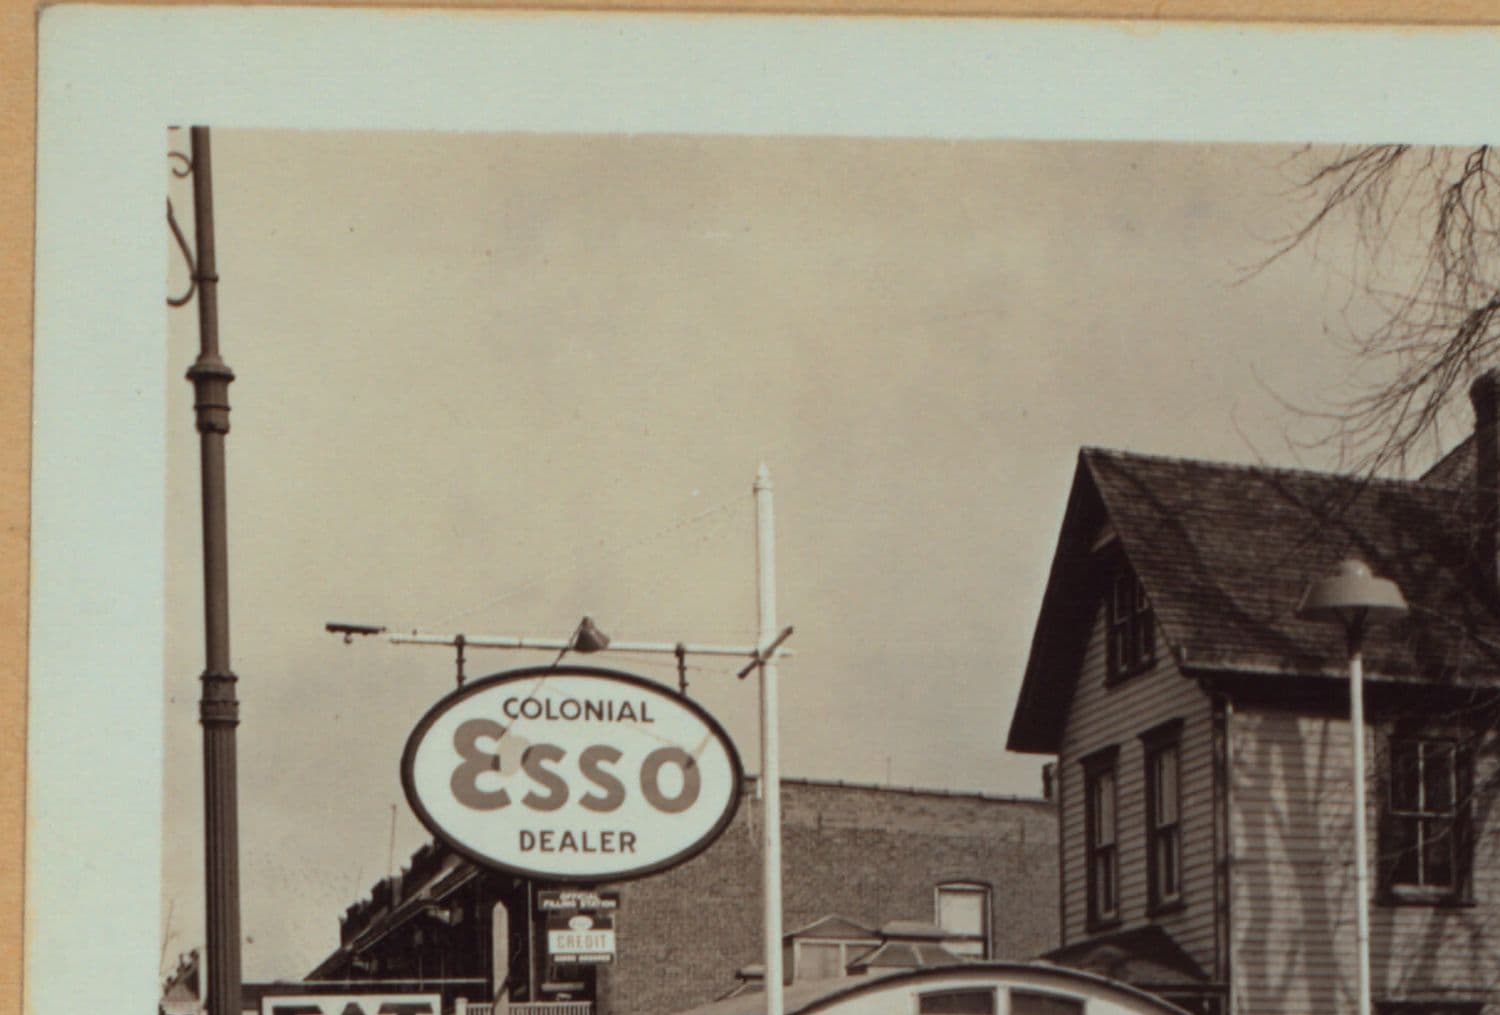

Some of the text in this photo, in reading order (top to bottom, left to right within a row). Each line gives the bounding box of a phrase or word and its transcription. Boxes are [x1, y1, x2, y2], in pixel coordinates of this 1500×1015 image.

[503, 697, 655, 723] COLONIAL
[450, 718, 702, 814] Esso
[519, 829, 637, 853] DEALER
[556, 934, 608, 950] CREDIT
